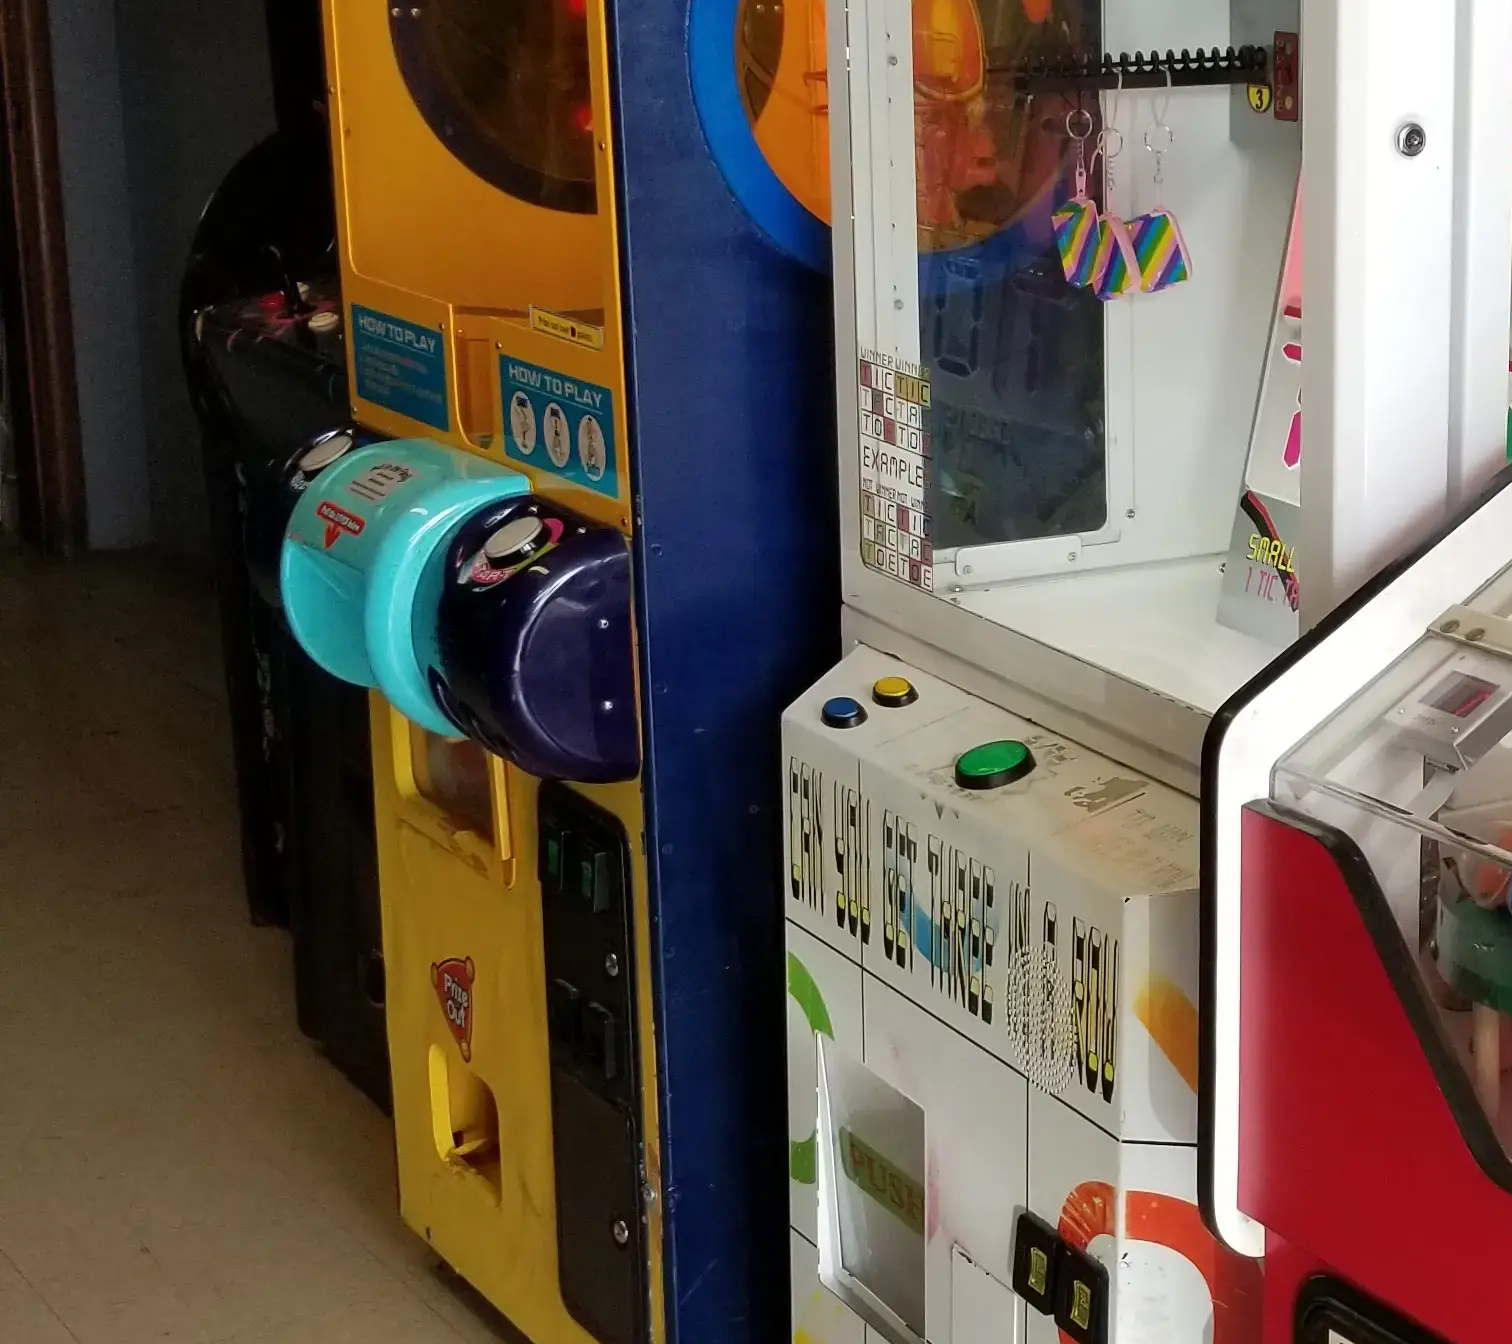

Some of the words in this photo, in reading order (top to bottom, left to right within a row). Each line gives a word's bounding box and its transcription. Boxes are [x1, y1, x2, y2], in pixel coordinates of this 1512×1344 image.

[1256, 88, 1264, 110] 3
[359, 314, 386, 336] HOW
[388, 323, 403, 342] TO
[404, 331, 436, 354] PLAY
[860, 346, 894, 368] WINNER
[508, 363, 542, 388] HOW
[544, 375, 562, 395] TO
[565, 382, 603, 408] PLAY
[1246, 532, 1295, 573] SMALL
[790, 756, 824, 917] CAN
[834, 779, 872, 946] YOU
[927, 833, 995, 1026] THREE
[1072, 915, 1119, 1104] ROW
[444, 972, 469, 1008] Prize
[447, 999, 466, 1029] Out
